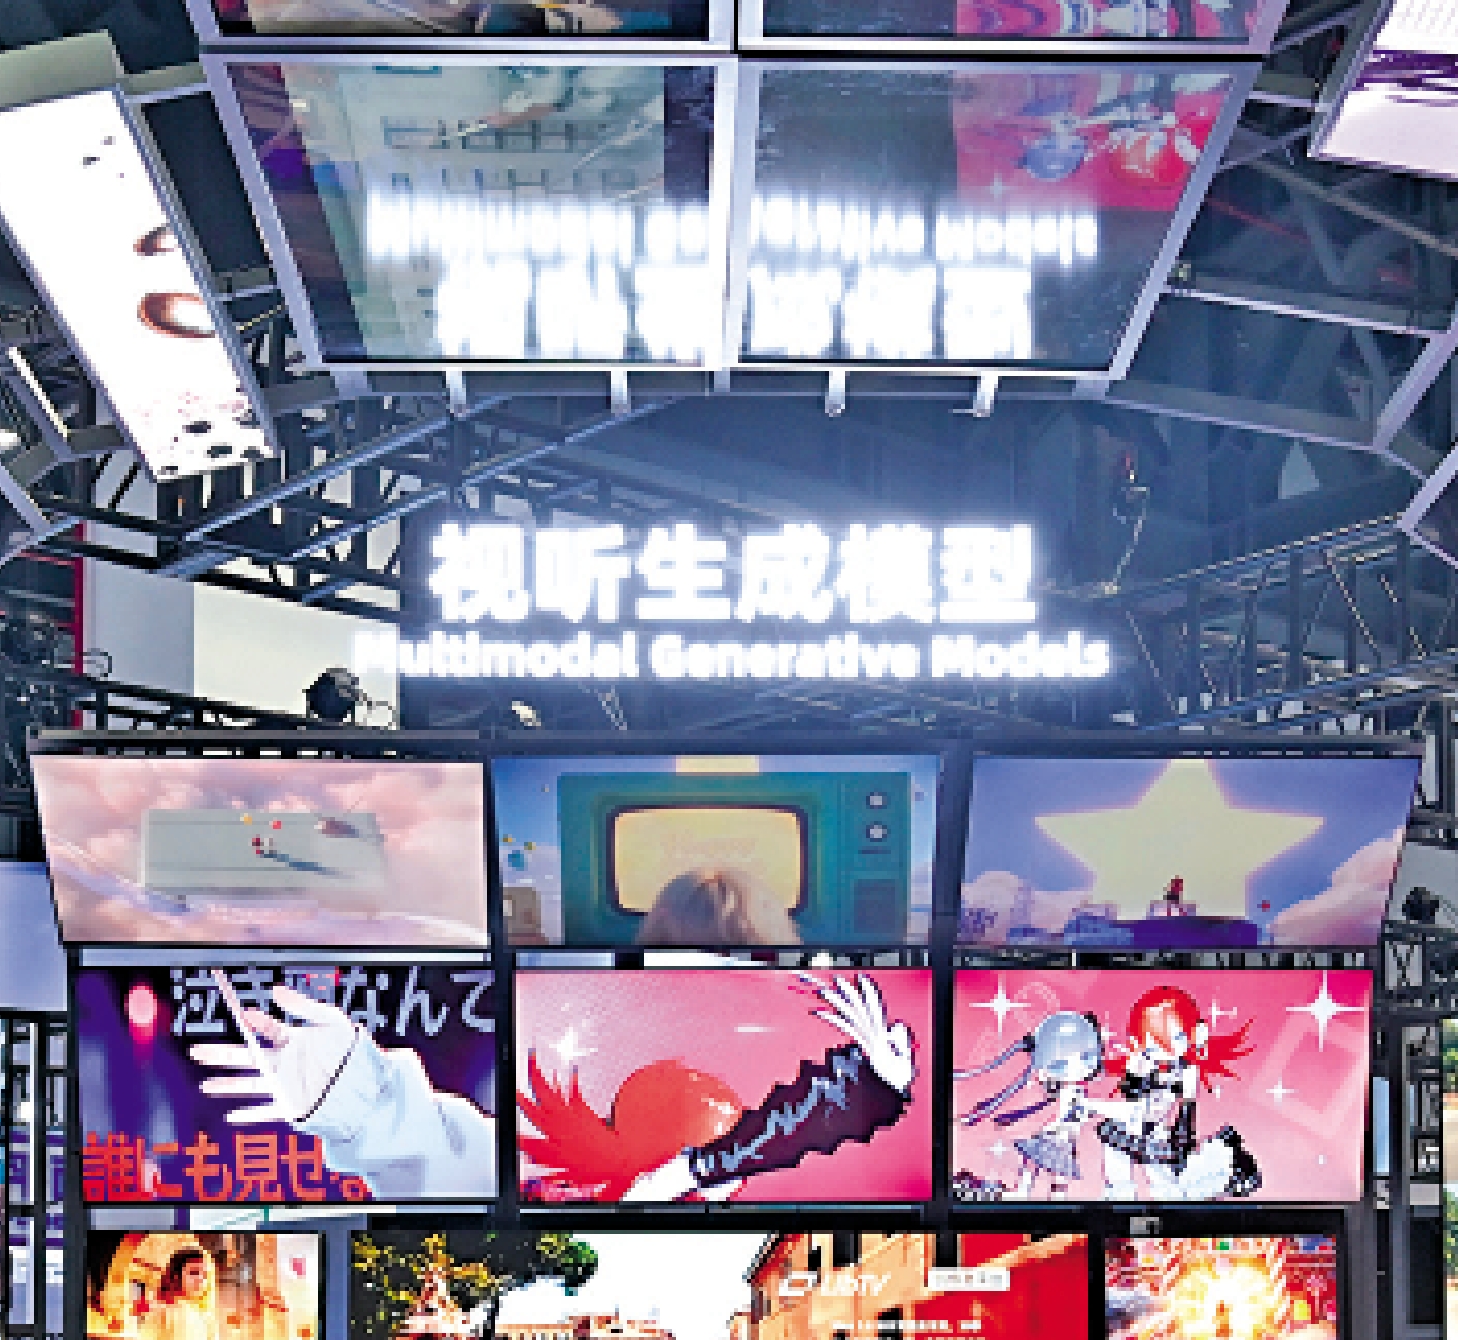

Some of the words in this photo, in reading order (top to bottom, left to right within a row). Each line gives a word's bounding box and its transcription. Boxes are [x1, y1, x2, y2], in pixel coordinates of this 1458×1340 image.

[429, 523, 1037, 624] 视听生成模型
[353, 631, 639, 681] Multimodal
[650, 631, 919, 681] Generative
[929, 631, 1111, 681] Models
